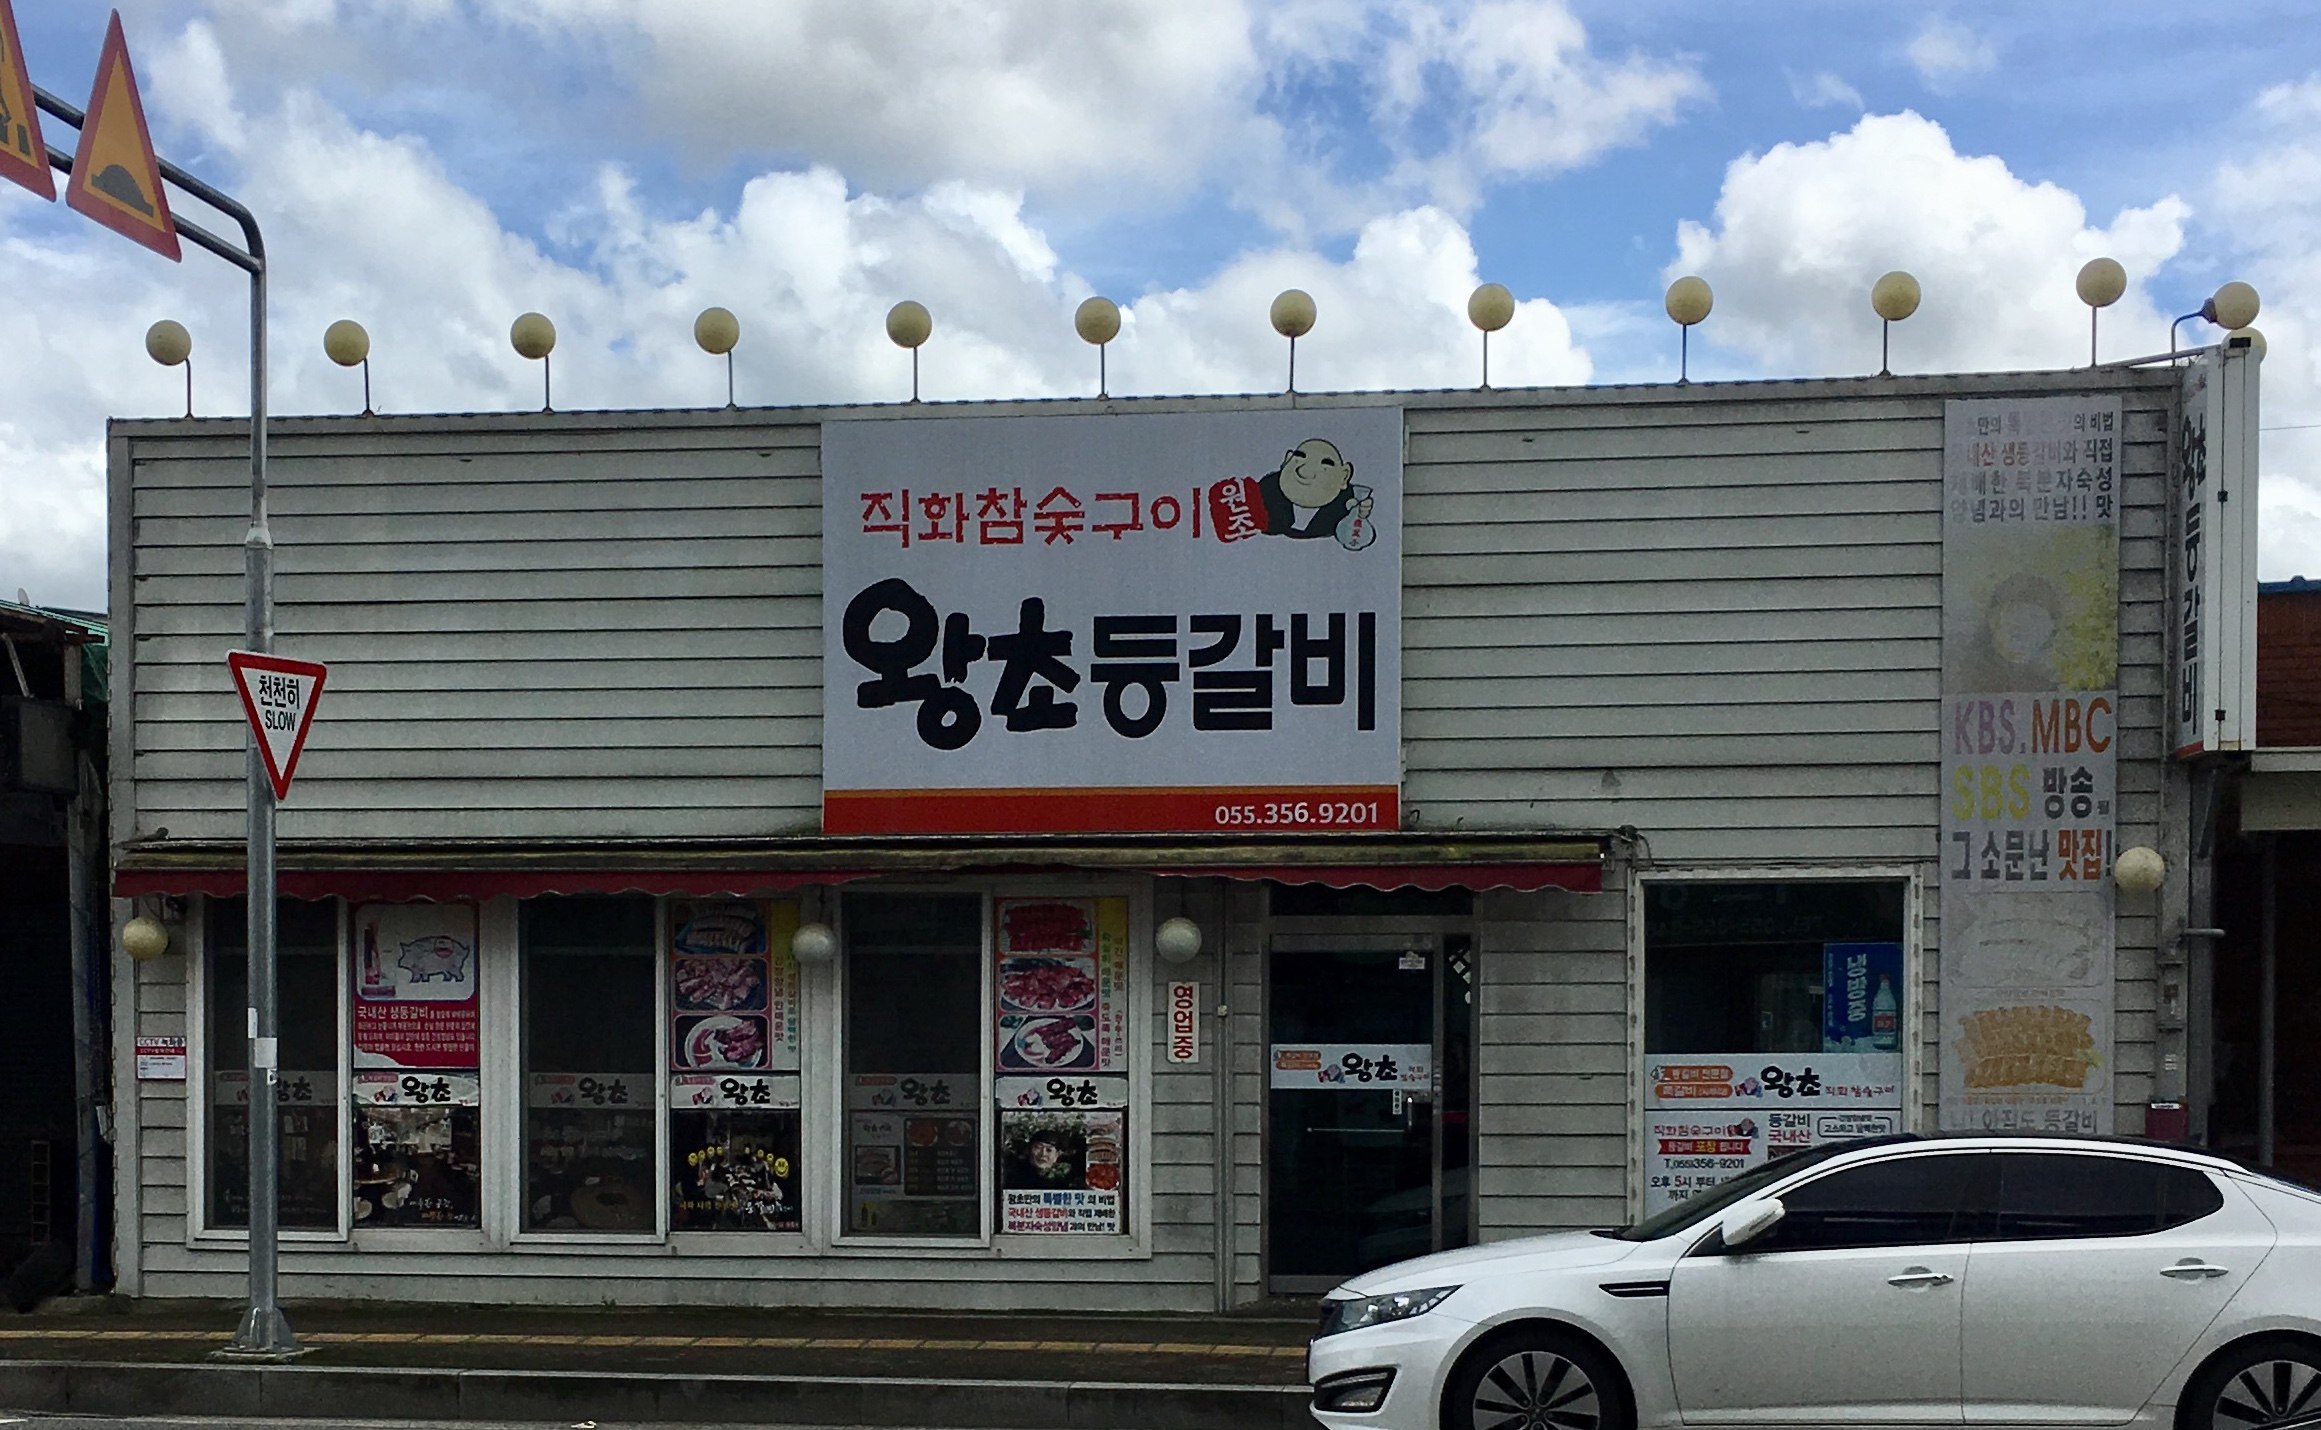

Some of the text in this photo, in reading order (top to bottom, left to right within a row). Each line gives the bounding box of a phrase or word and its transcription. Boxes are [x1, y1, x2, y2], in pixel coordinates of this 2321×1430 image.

[860, 487, 1202, 549] 직화참숯구이
[1218, 479, 1262, 540] 원조
[2096, 494, 2114, 519] 맛
[842, 577, 1376, 751] 왕초등갈비
[258, 674, 301, 710] 천천히
[265, 709, 297, 732] SLOW
[1951, 763, 2094, 822] SBS 방송
[1214, 801, 1379, 826] 055.356.9201
[1173, 985, 1194, 1059] 영업중
[1342, 1052, 1398, 1083] 왕초
[402, 1076, 451, 1103] 왕초
[579, 1077, 628, 1106] 왕초
[721, 1078, 771, 1105] 왕초
[901, 1078, 951, 1106] 왕초
[1046, 1078, 1098, 1106] 왕초
[1760, 1065, 1822, 1099] 왕초
[1768, 1113, 1811, 1128] 등갈비
[1768, 1128, 1812, 1144] 국내산
[1650, 1175, 1671, 1188] 오후
